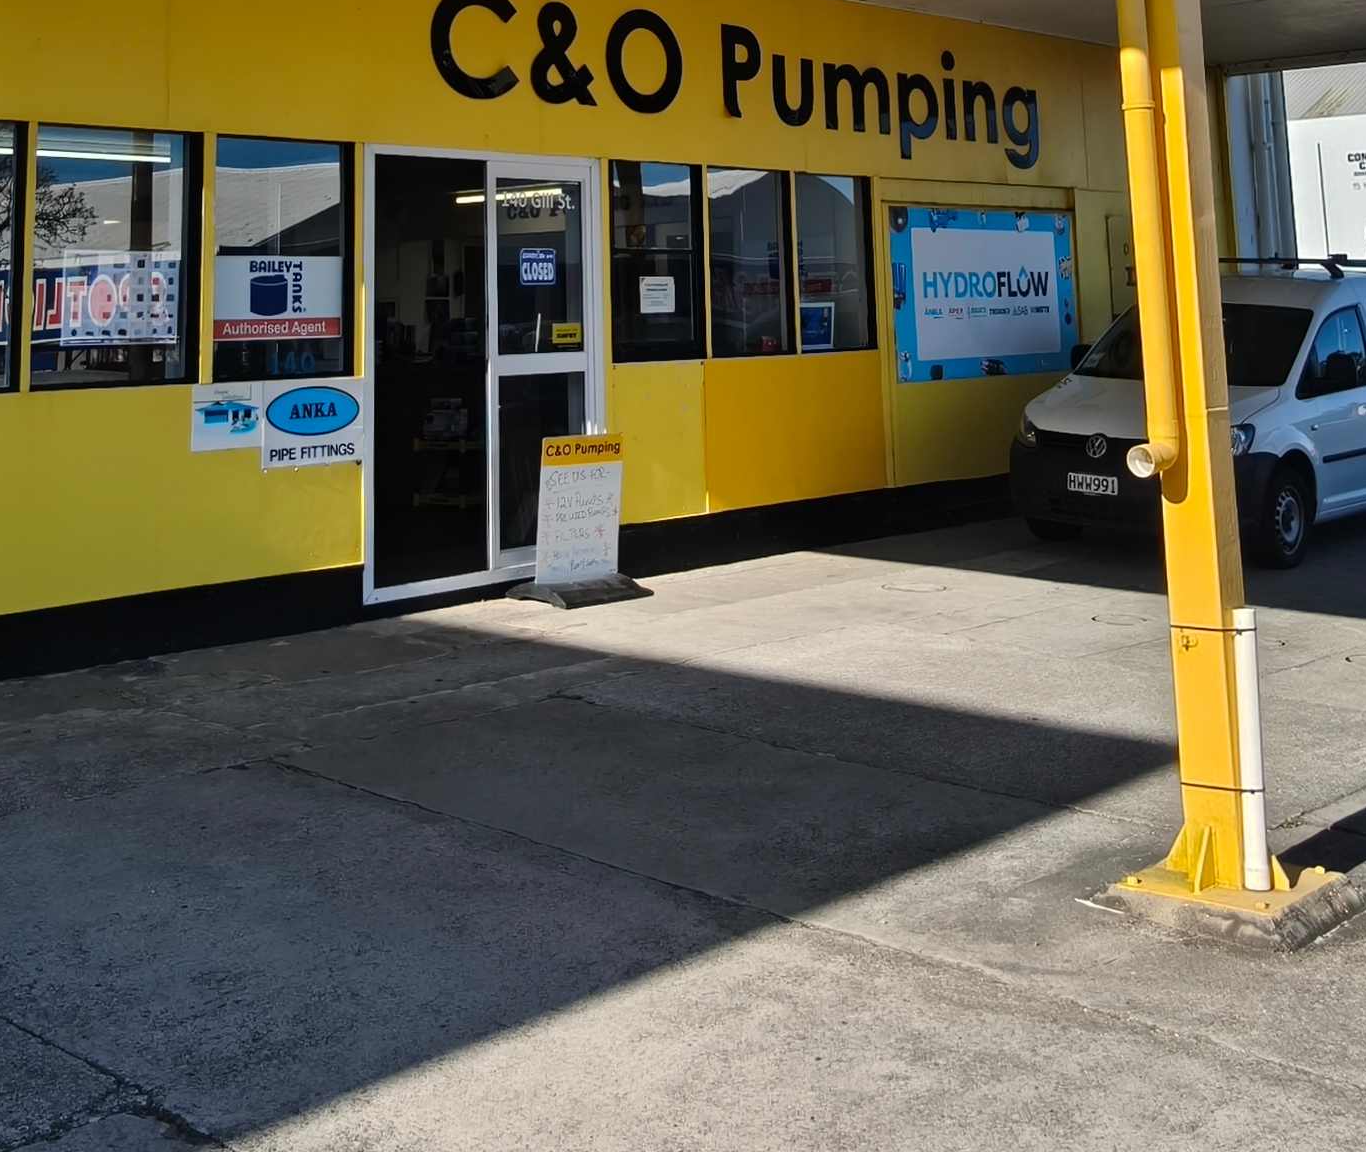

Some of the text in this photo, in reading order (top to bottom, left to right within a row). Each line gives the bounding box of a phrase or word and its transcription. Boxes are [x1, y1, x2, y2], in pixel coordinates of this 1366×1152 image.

[720, 23, 1041, 170] Pumping
[250, 260, 292, 273] BAILEY
[522, 262, 554, 281] CLOSED
[292, 261, 303, 313] TANKS
[923, 268, 1048, 298] HYDROFLOW
[222, 320, 326, 335] Authorised Agent
[289, 402, 337, 420] ANKA
[269, 443, 355, 462] PIPE FITTINGS
[546, 441, 620, 456] C&O Pumping
